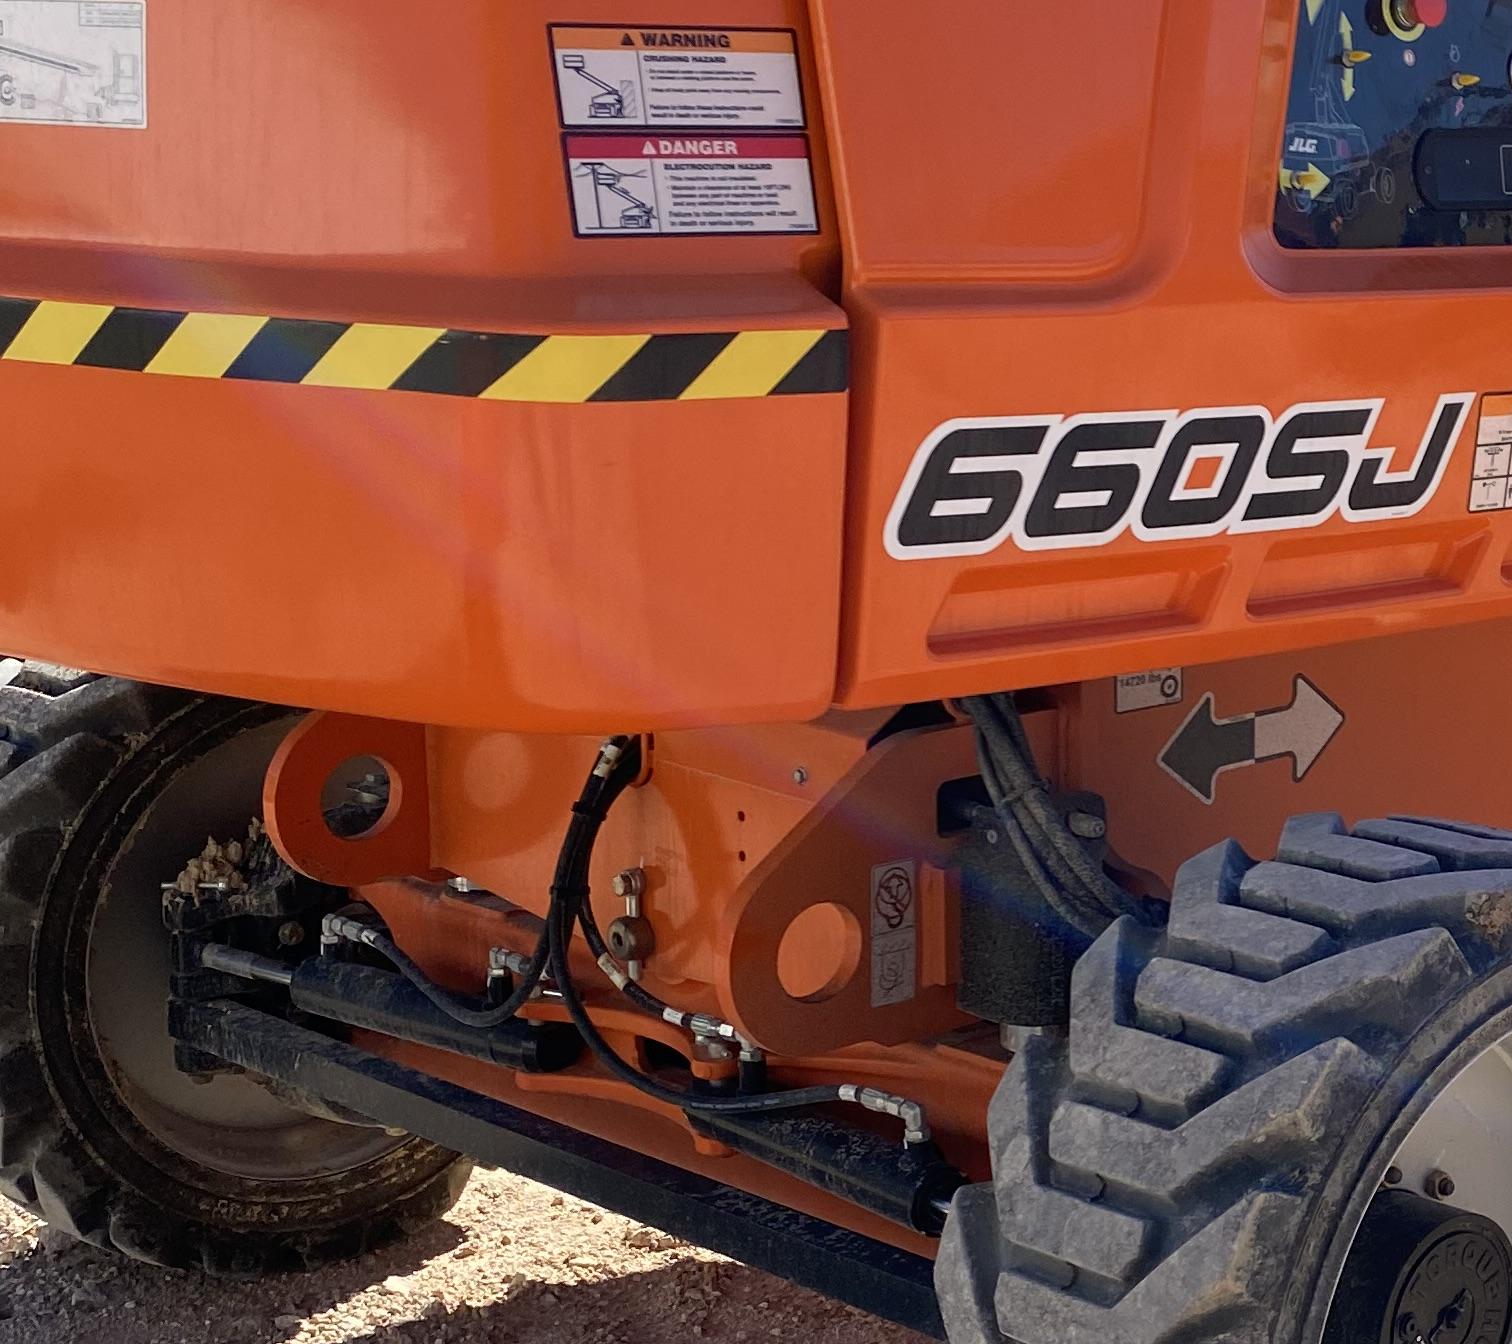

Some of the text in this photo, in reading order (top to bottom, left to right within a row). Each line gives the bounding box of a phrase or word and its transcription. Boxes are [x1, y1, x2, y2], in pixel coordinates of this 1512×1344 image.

[639, 32, 731, 48] WARNING
[658, 140, 739, 155] DANGER
[1288, 137, 1319, 154] JLG
[888, 393, 1473, 557] 660SJ
